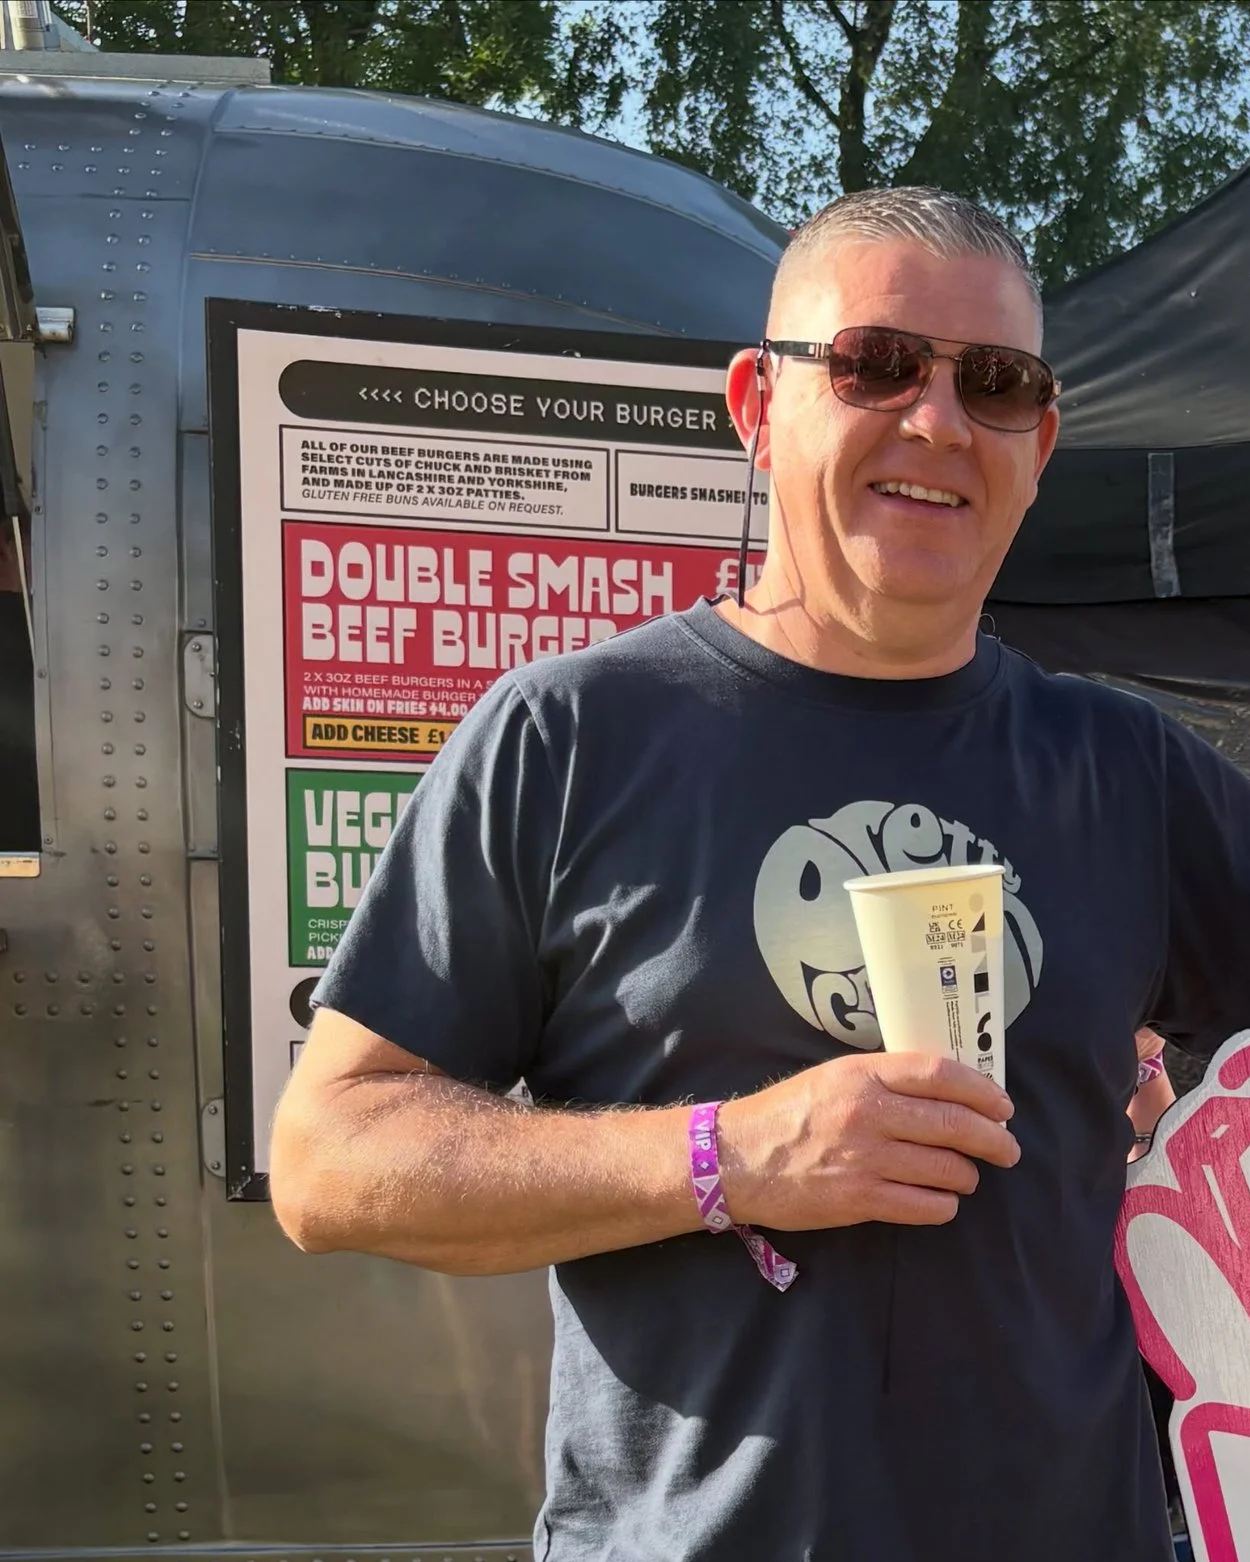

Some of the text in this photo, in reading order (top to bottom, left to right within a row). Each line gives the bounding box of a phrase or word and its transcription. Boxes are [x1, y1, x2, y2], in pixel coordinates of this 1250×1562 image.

[415, 387, 717, 431] CHOOSE YOUR BURGER
[301, 440, 593, 470] ALL OF OUR BEEF BURGERS ARE MADE USING
[301, 452, 591, 481] SELECT CUTS OF CHUCK AND BRISKET FROM
[301, 464, 568, 492] FARMS IN LANCASHIRE AND YORKSHIRE,
[302, 477, 331, 488] AND
[334, 479, 373, 490] MADE
[375, 481, 393, 492] UP
[396, 483, 414, 493] OF
[416, 484, 425, 494] 2
[426, 485, 435, 495] X
[467, 488, 525, 501] PATTIES.
[302, 489, 564, 515] GLUTEN FREE BUNS AVAILABLE ON REQUEST.
[630, 482, 769, 505] BURGERS SMASHE TO
[300, 539, 673, 616] DOUBLE SMASH
[301, 601, 417, 665] BEEF
[304, 673, 313, 682] 2
[313, 673, 323, 683] X
[355, 674, 389, 685] BEEF
[392, 676, 454, 688] BURGERS
[457, 679, 471, 689] IN
[473, 680, 483, 690] A
[304, 685, 338, 697] WITH
[342, 687, 420, 700] HOMEMADE
[423, 690, 477, 702] BURGER
[303, 697, 330, 711] ADD
[332, 699, 364, 713] SKIN
[367, 700, 385, 714] ON
[387, 701, 428, 715] FRIES
[312, 723, 349, 741] ADD
[352, 724, 420, 744] CHEESE
[304, 789, 413, 848] VEG
[305, 851, 382, 909] BU
[308, 918, 348, 930] CRISP
[695, 1119, 711, 1150] VIP
